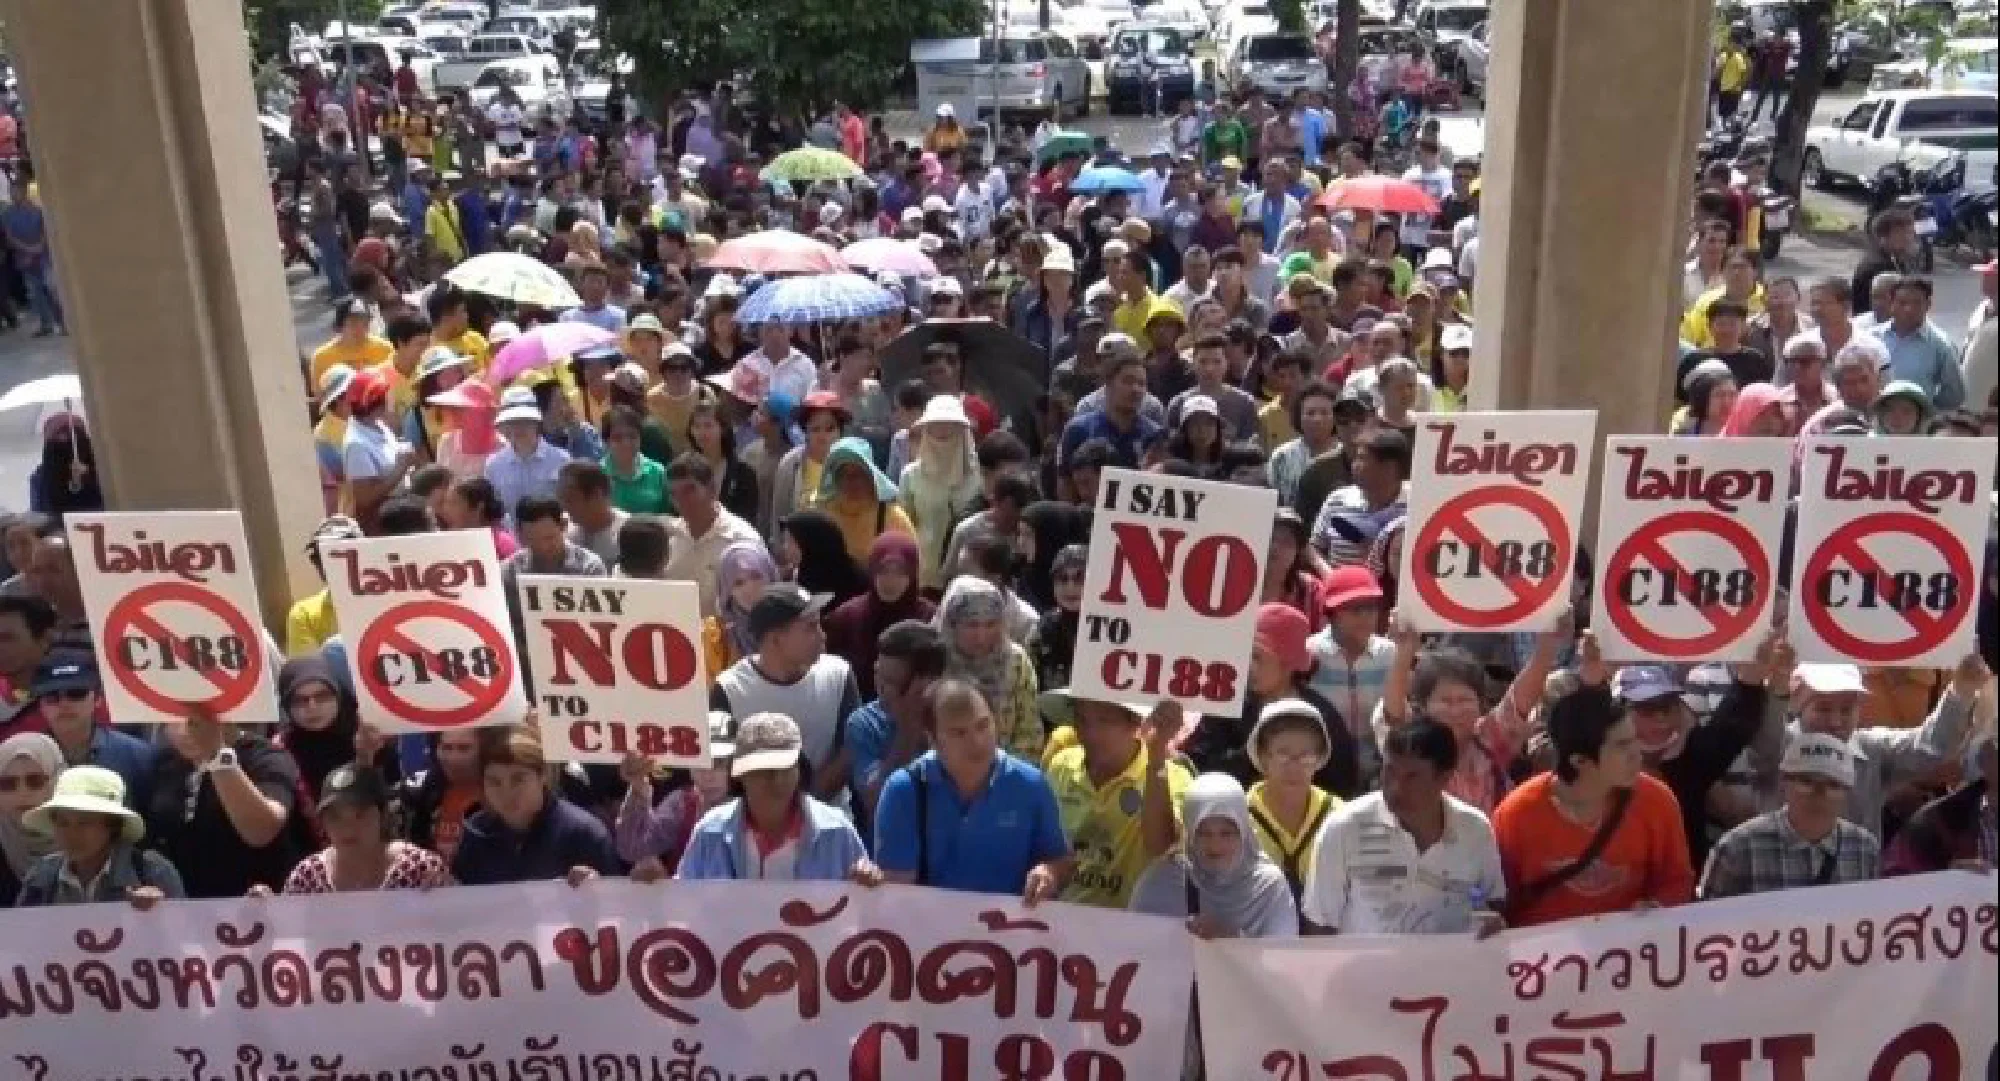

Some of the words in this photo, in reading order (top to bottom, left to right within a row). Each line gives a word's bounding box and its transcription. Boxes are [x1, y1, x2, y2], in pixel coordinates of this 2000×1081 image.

[1426, 424, 1576, 486] ไม่เอา
[1104, 481, 1120, 511] I
[1129, 484, 1206, 521] SAY
[1616, 446, 1774, 512] ไม่เอา
[1815, 446, 1976, 513] ไม่เอา
[74, 523, 236, 581] ไม่เอา
[1099, 521, 1259, 619] NO
[1426, 542, 1557, 579] C188
[330, 549, 487, 600] ไม่เอา
[1617, 567, 1757, 611] C188
[1815, 567, 1960, 612] C188
[526, 586, 542, 611] I
[553, 587, 627, 614] SAY
[1085, 614, 1133, 645] TO
[118, 636, 248, 672] C188
[373, 648, 500, 687] C188
[541, 619, 697, 691] NO
[1100, 648, 1239, 703] C188
[542, 695, 590, 719] TO
[568, 720, 702, 757] C188
